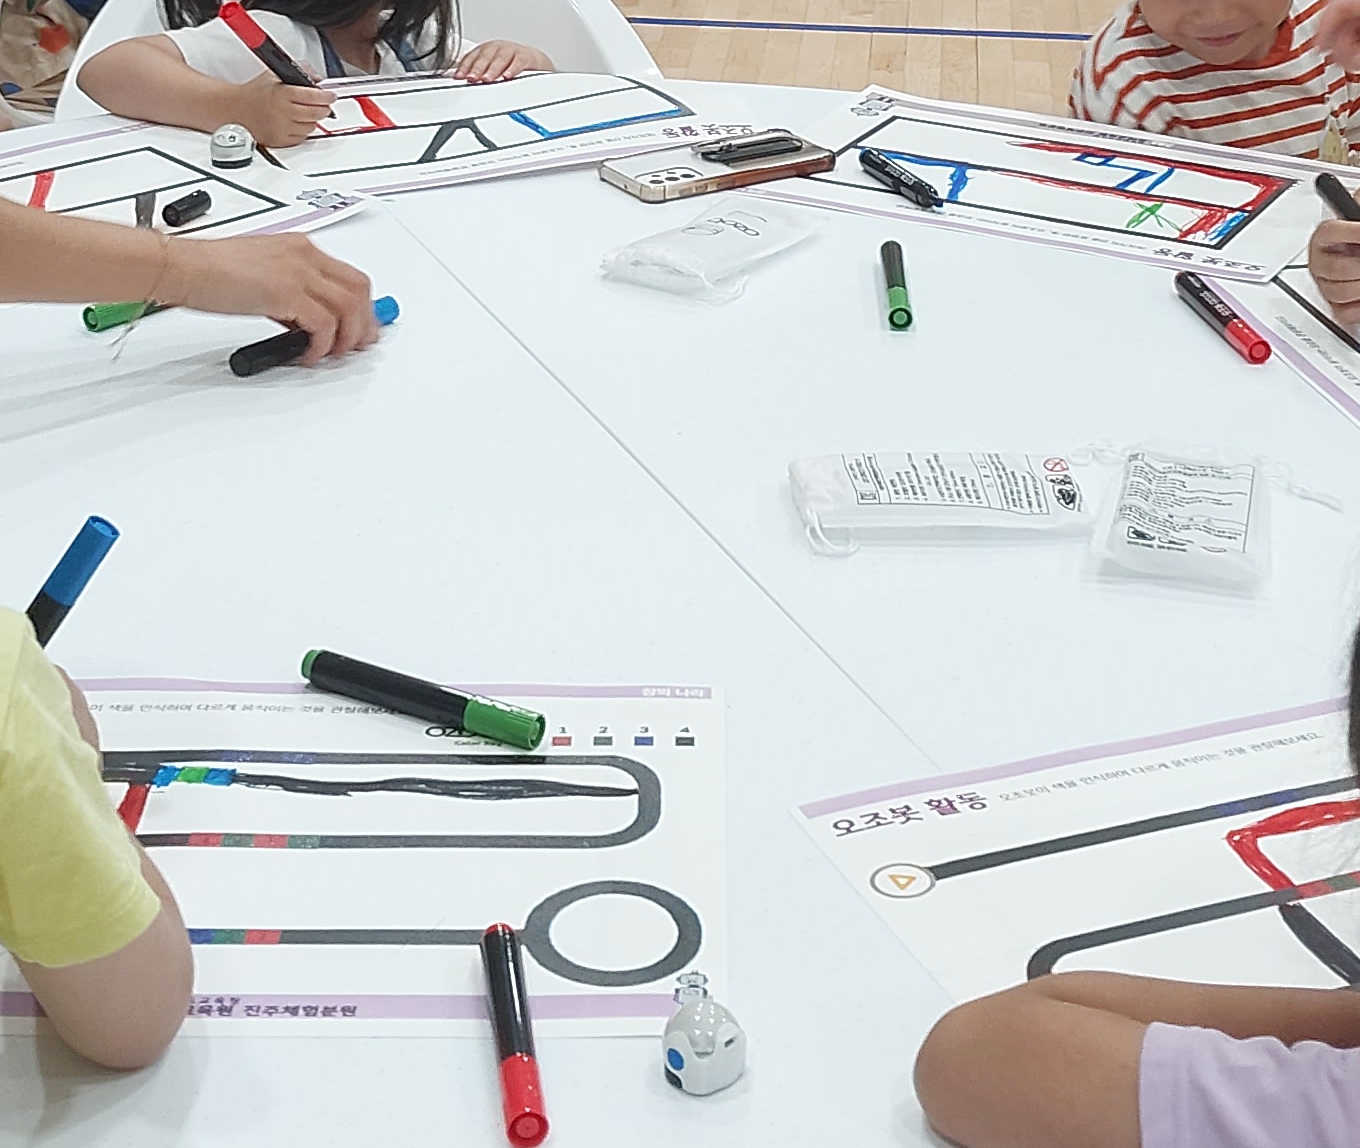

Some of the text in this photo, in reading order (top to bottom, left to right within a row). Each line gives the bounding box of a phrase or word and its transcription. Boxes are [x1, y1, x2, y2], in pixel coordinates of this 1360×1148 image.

[558, 725, 691, 734] 1 2 3 4
[832, 791, 988, 838] 오조봇 활동
